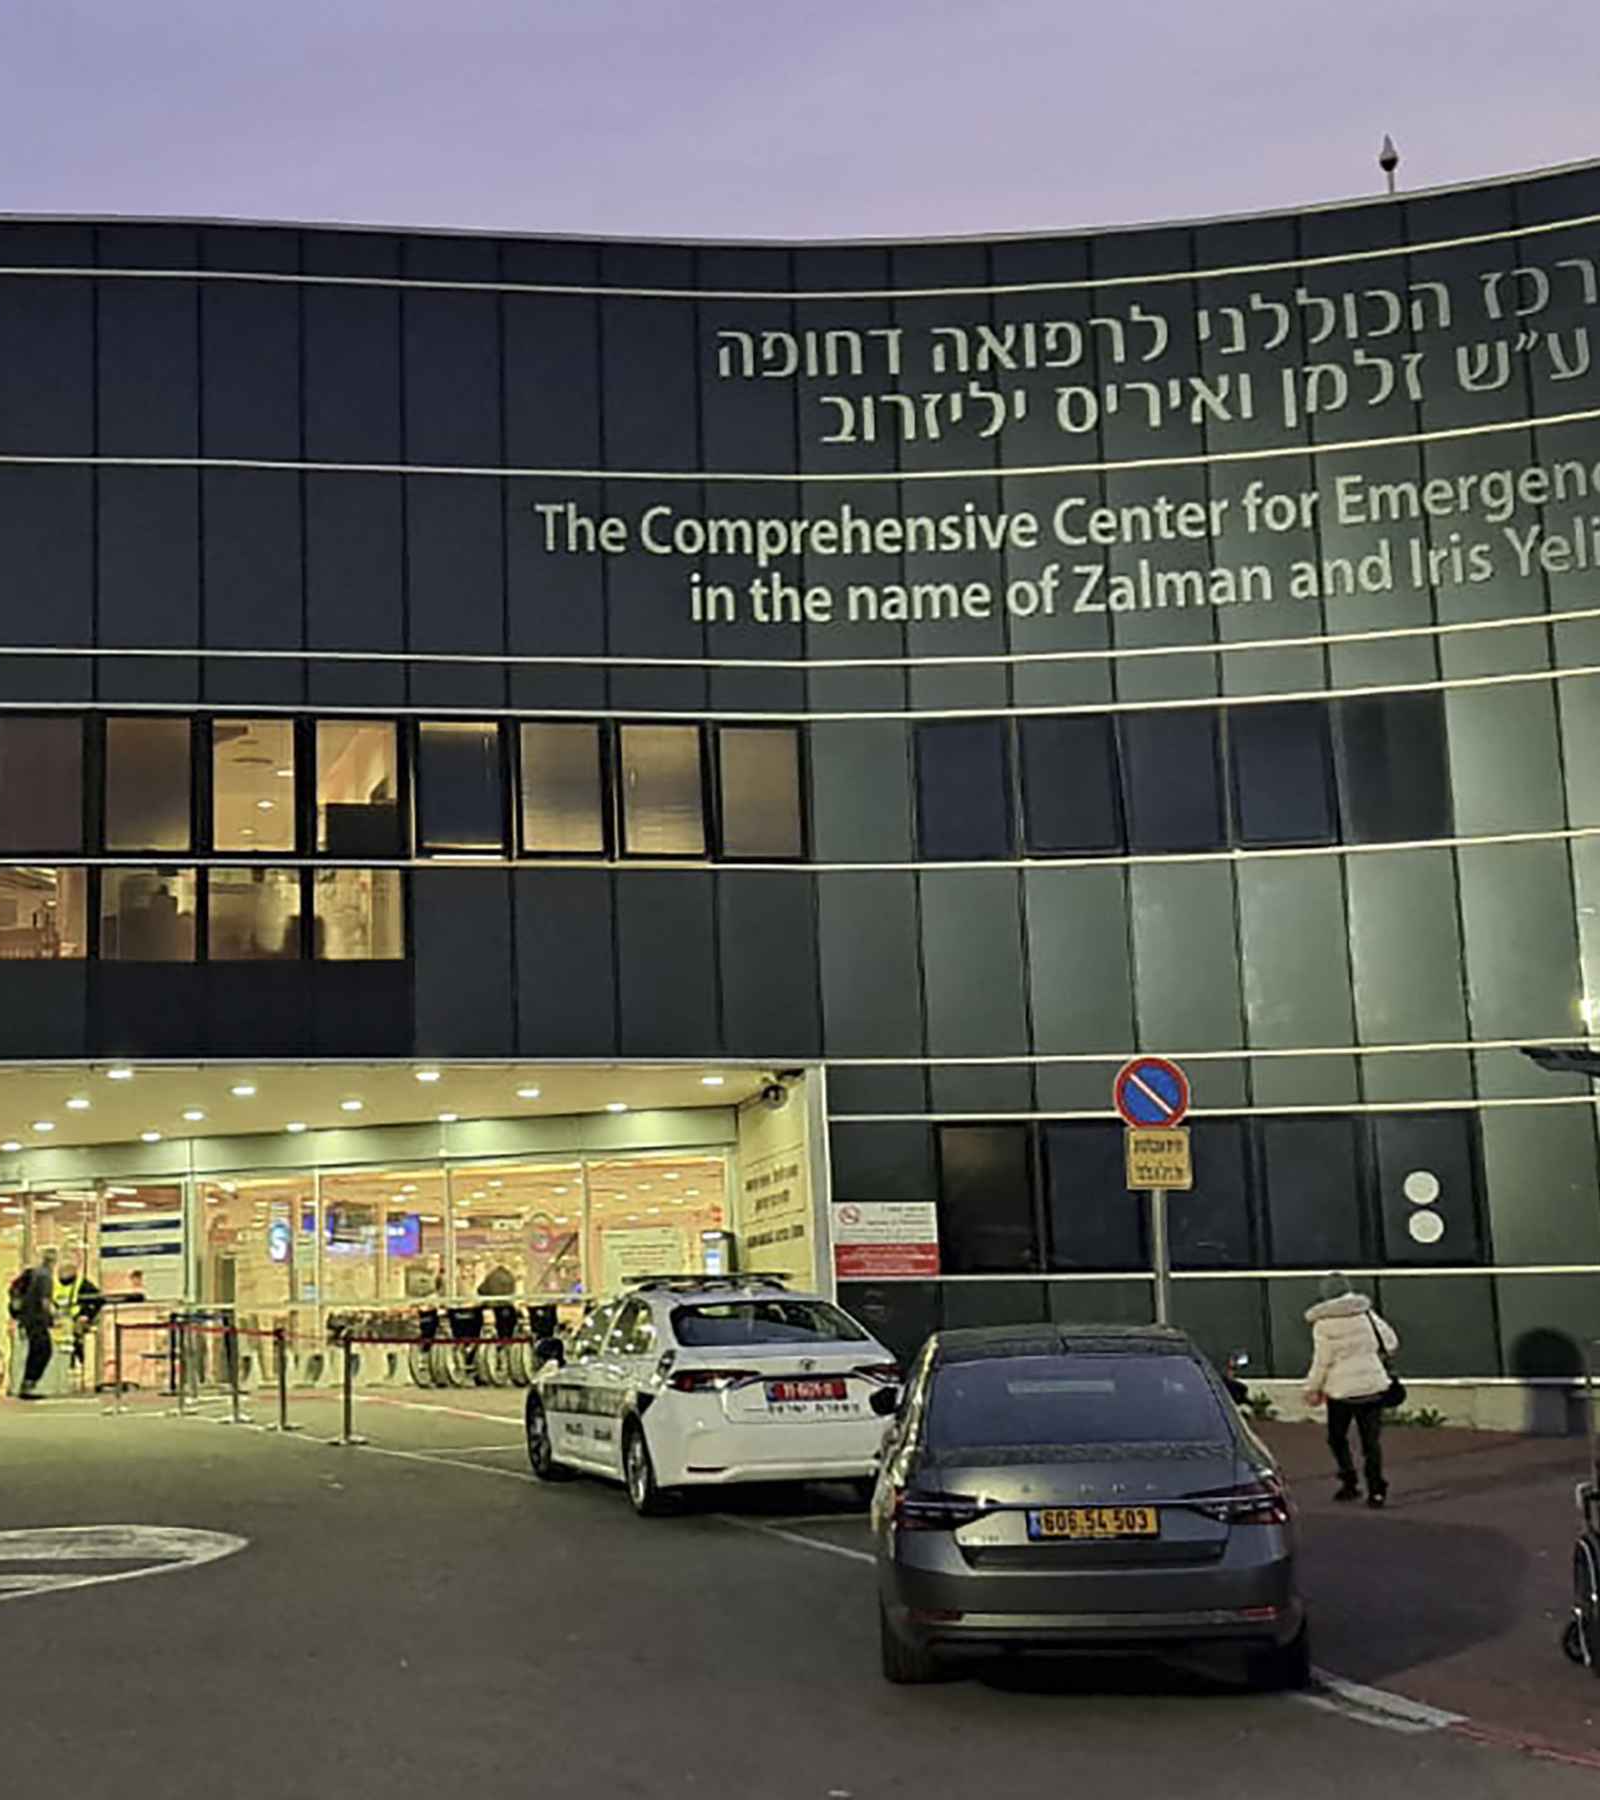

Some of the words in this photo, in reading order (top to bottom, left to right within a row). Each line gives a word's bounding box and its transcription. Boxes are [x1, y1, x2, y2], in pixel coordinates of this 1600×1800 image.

[717, 328, 903, 378] דחופה
[930, 304, 1168, 374] לרפואה
[1197, 281, 1451, 357] הכוללני
[819, 381, 1028, 443] יליזרוב
[1055, 373, 1254, 433] ואיריס
[1282, 348, 1425, 428] זלמן
[534, 502, 628, 553] The
[640, 501, 1040, 568] Comprehensive
[1053, 494, 1229, 547] Center
[1241, 481, 1321, 533] for
[691, 572, 735, 622] in
[749, 571, 833, 623] the
[847, 580, 992, 623] name
[1006, 563, 1061, 618] of
[1072, 554, 1273, 614] Zalman
[1290, 539, 1394, 600] and
[1410, 532, 1493, 588] Iris
